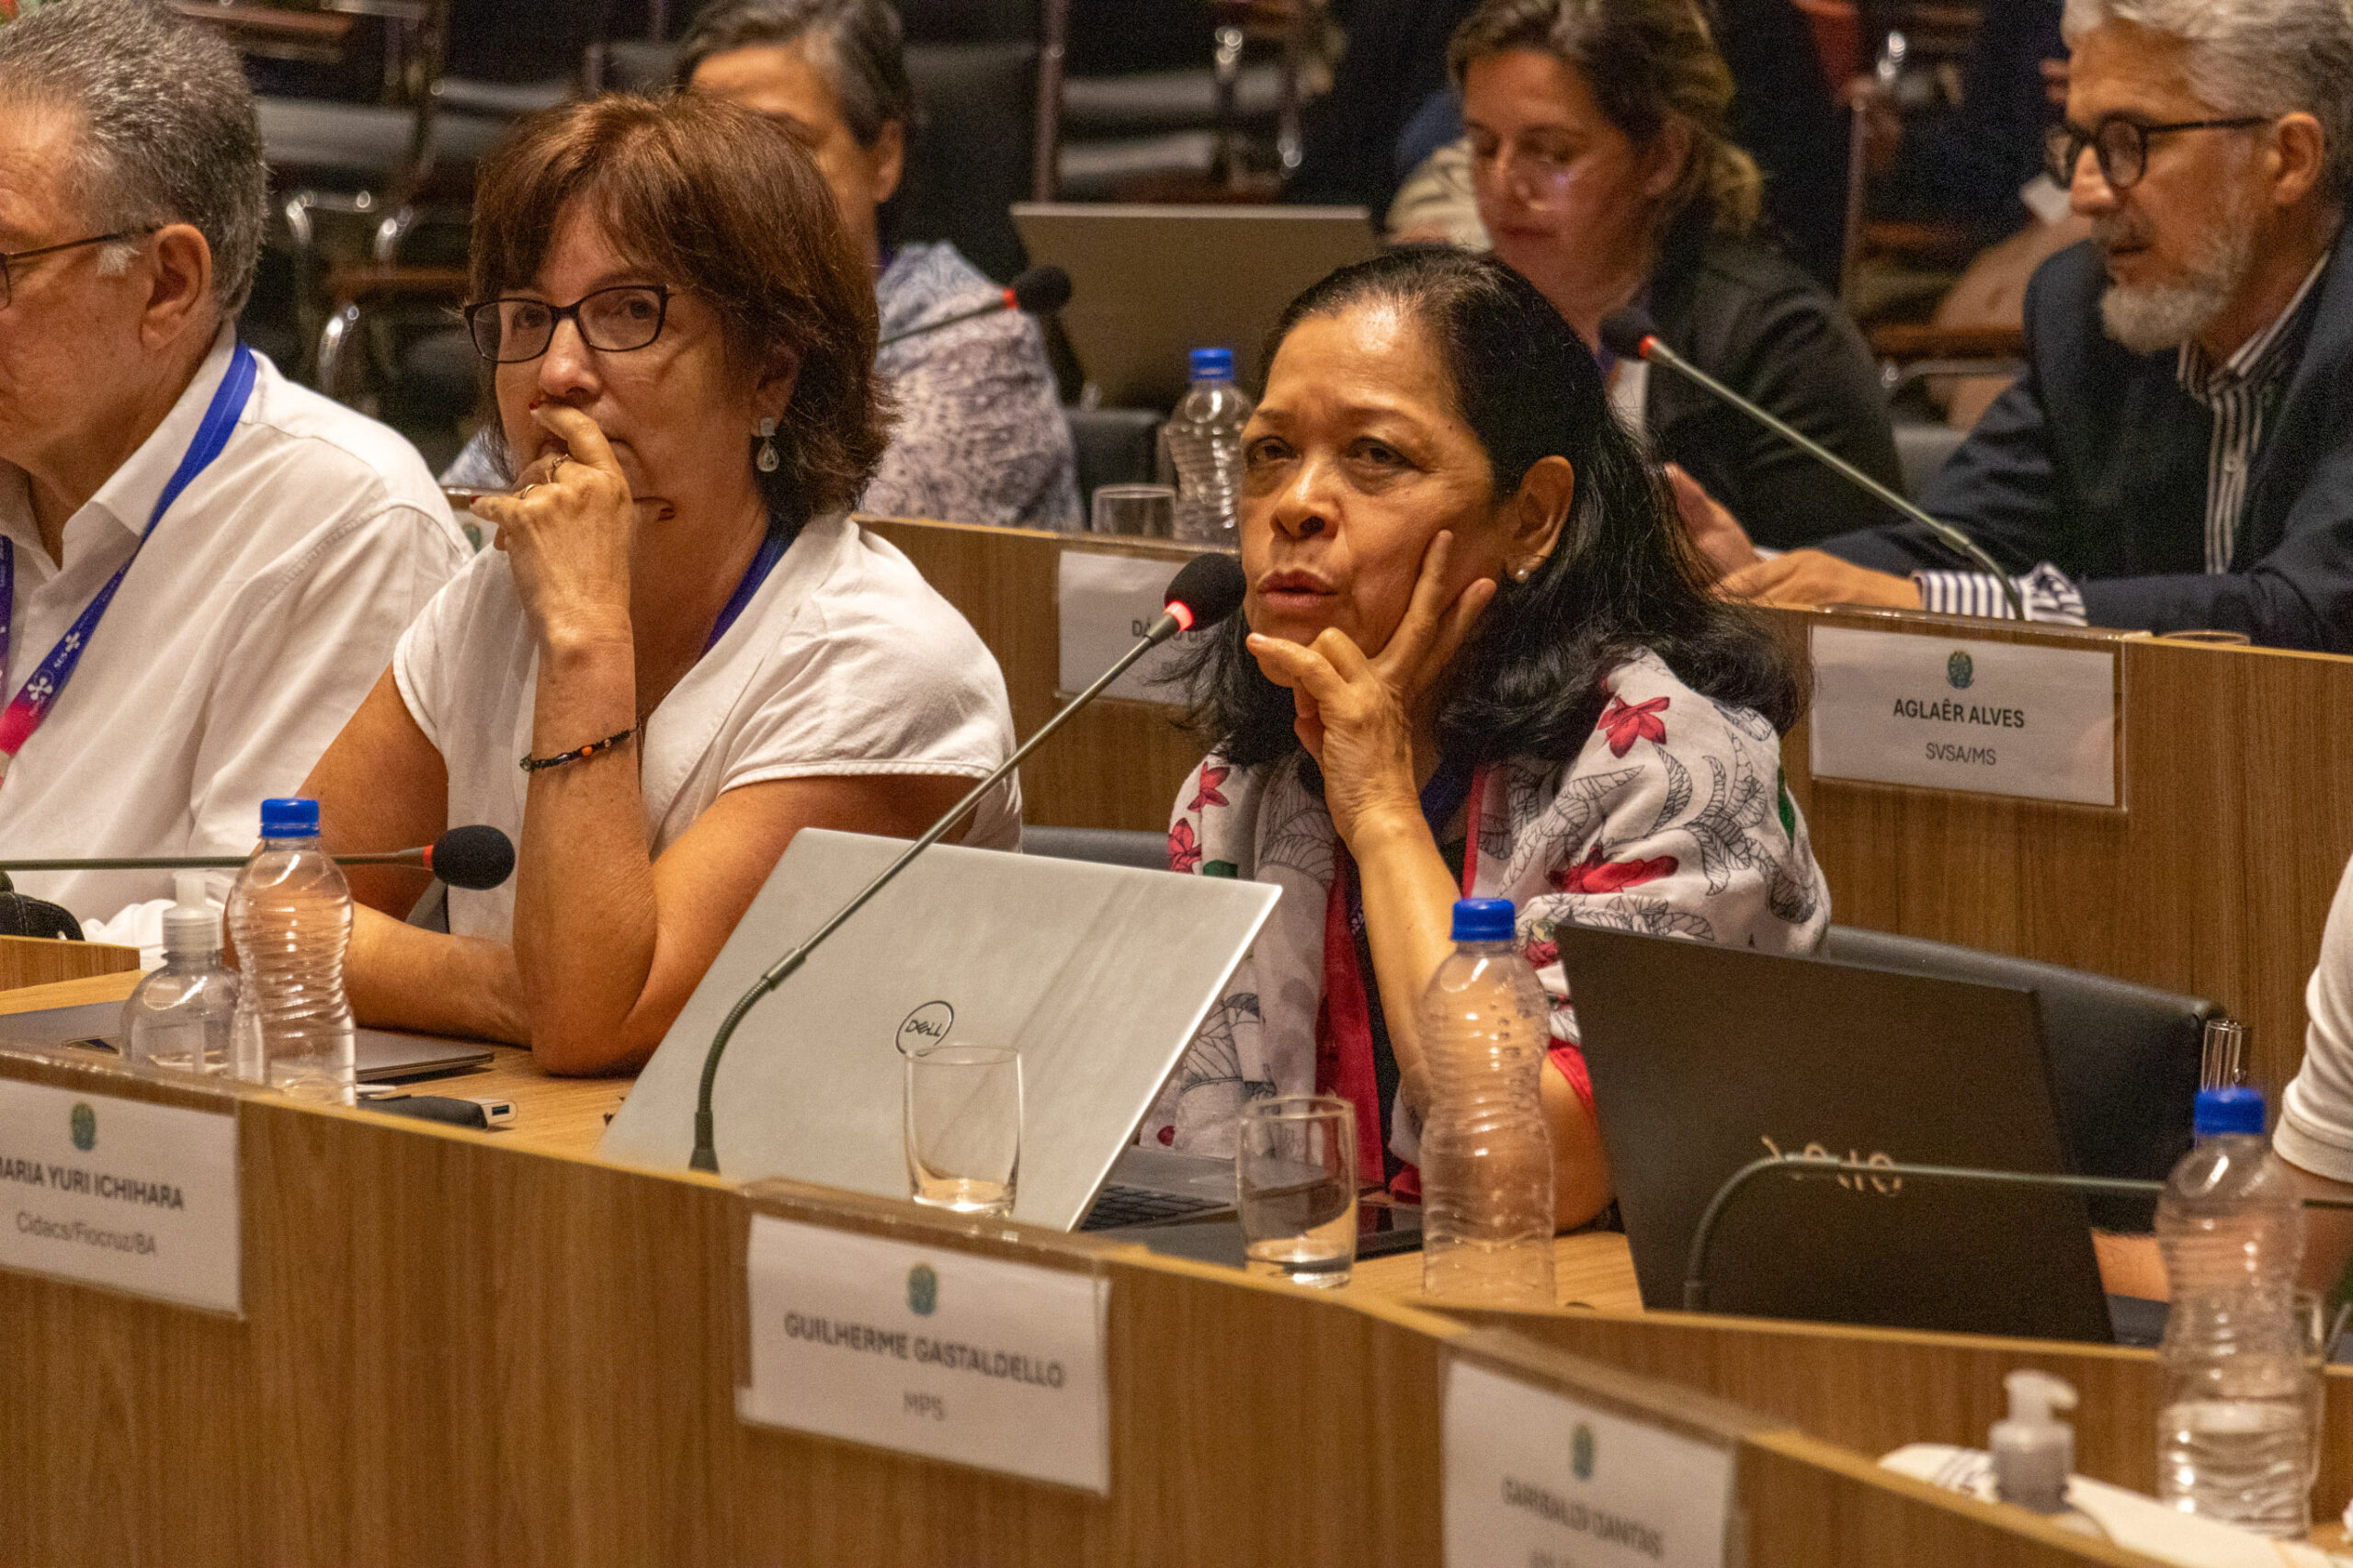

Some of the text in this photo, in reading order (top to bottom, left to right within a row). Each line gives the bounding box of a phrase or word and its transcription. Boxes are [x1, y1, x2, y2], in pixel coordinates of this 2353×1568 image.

[1893, 699, 2025, 728] AGLAÊR ALVES
[1926, 743, 1996, 766] SVSA/MS
[904, 1019, 942, 1037] DELL
[49, 1165, 89, 1195] YURI
[94, 1175, 184, 1210] ICHIHARA
[784, 1312, 1065, 1389] GUILHERME GASTALDELLO
[904, 1391, 945, 1422] MPS
